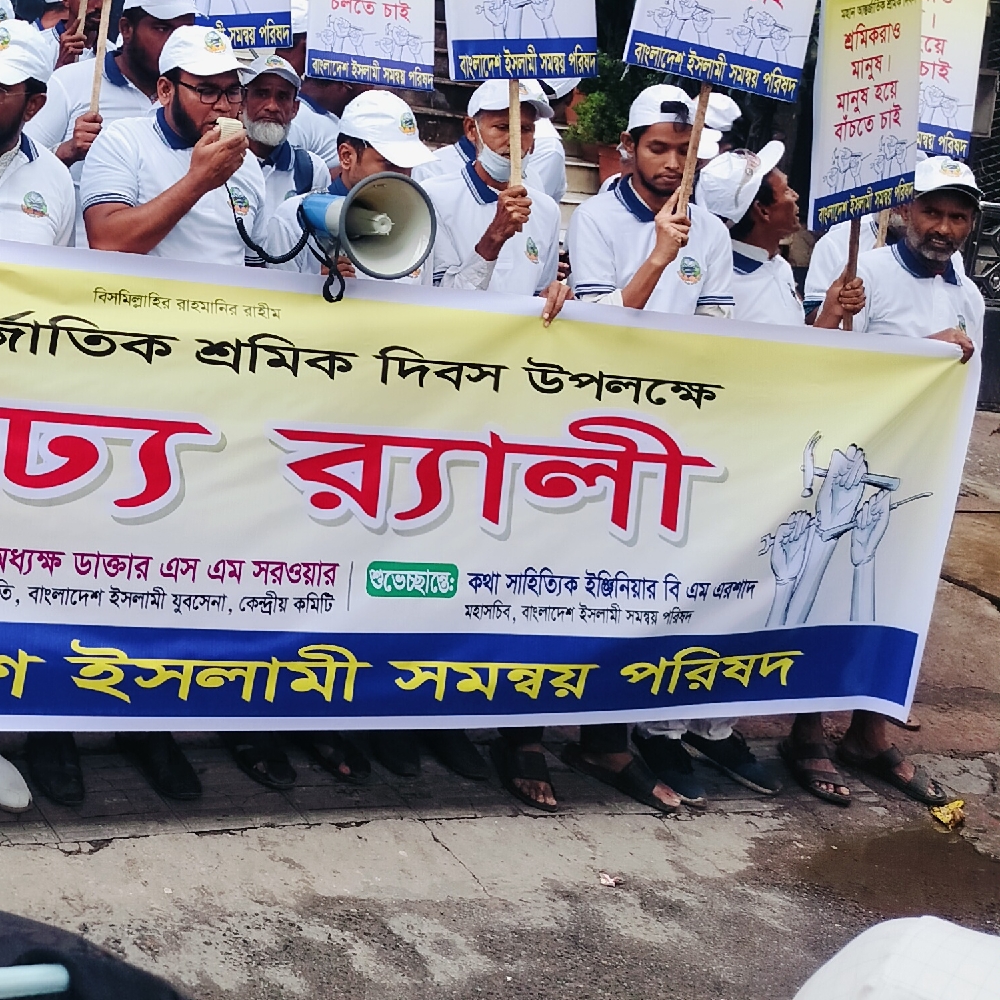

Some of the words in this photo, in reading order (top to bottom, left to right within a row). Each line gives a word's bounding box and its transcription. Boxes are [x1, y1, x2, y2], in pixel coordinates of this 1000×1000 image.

[93, 286, 171, 310] বিসমিল্লাহির
[176, 298, 239, 317] রাহমানির
[243, 302, 282, 320] রাহীম
[195, 333, 357, 382] শ্রমিক
[374, 346, 508, 394] দিবস
[523, 355, 725, 410] উপলক্ষে
[271, 413, 718, 537] র‍্যালী
[73, 551, 154, 582] ডাক্তার
[159, 555, 202, 584] এস
[207, 558, 245, 585] এম
[252, 559, 340, 588] সরওয়ার
[467, 571, 502, 595] কথা
[504, 567, 581, 597] সাহিত্যিক
[584, 567, 659, 602] ইঞ্জিনিয়ার
[663, 574, 681, 602] বি
[685, 579, 711, 600] এম
[712, 578, 759, 602] এরশাদ
[28, 585, 105, 607] বাংলাদেশ
[109, 584, 167, 611] ইসলামী
[238, 592, 288, 616] কেন্দ্রীয়
[293, 591, 335, 614] কমিটি
[521, 604, 576, 624] বাংলাদেশ
[579, 601, 622, 625] ইসলামী
[625, 608, 660, 627] সমন্বয়
[662, 607, 696, 626] পরিষদ
[63, 638, 373, 704] ইসলামী
[388, 659, 600, 701] সমন্বয়
[619, 645, 806, 697] পরিষদ
